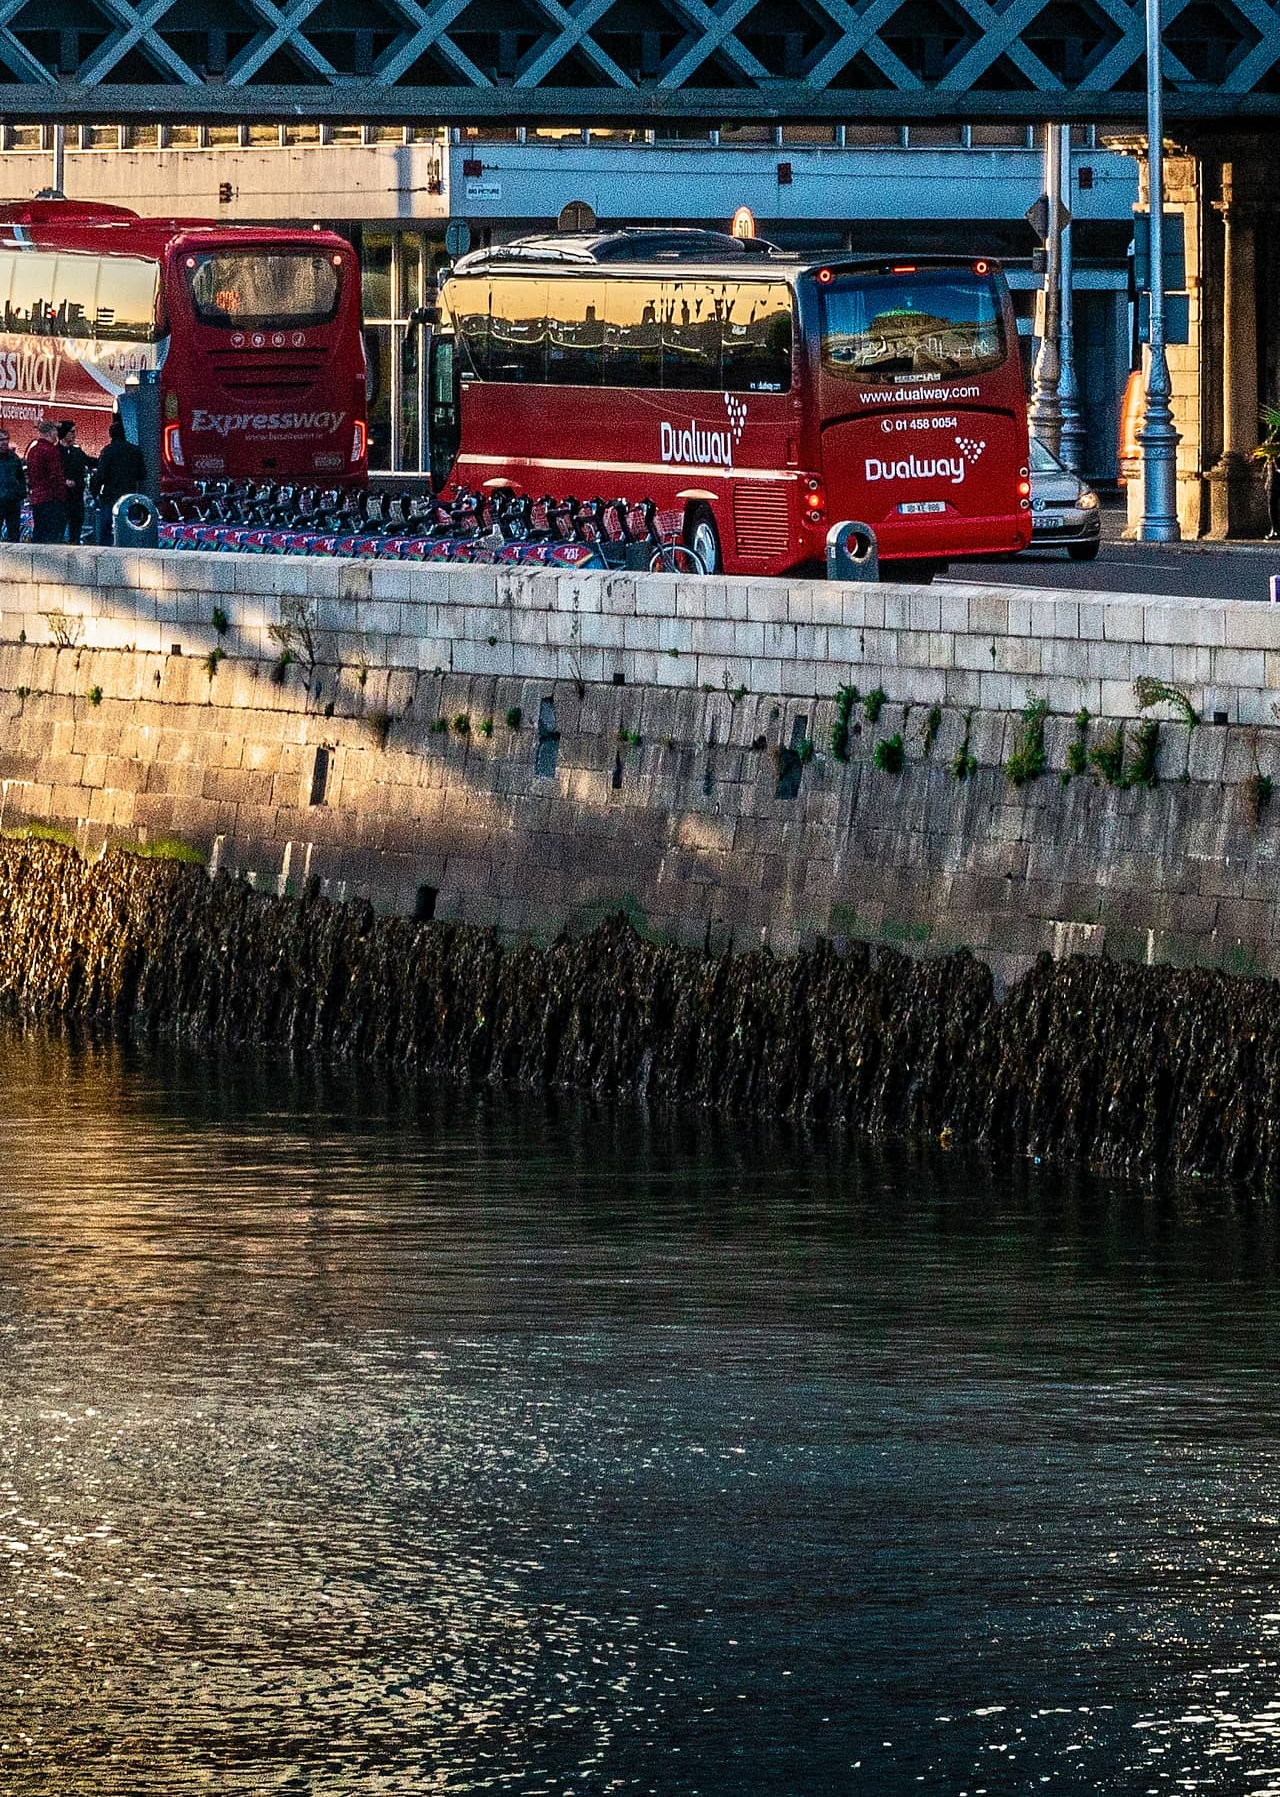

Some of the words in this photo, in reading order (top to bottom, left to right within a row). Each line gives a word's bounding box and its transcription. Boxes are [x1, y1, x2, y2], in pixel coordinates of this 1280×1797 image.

[738, 220, 749, 238] 50
[860, 386, 980, 403] www.dualway.com
[191, 409, 347, 437] Expressway
[895, 418, 907, 430] 01
[909, 418, 930, 430] 458
[932, 417, 958, 429] 0054
[660, 419, 734, 478] Dualway
[865, 454, 965, 484] Dualway
